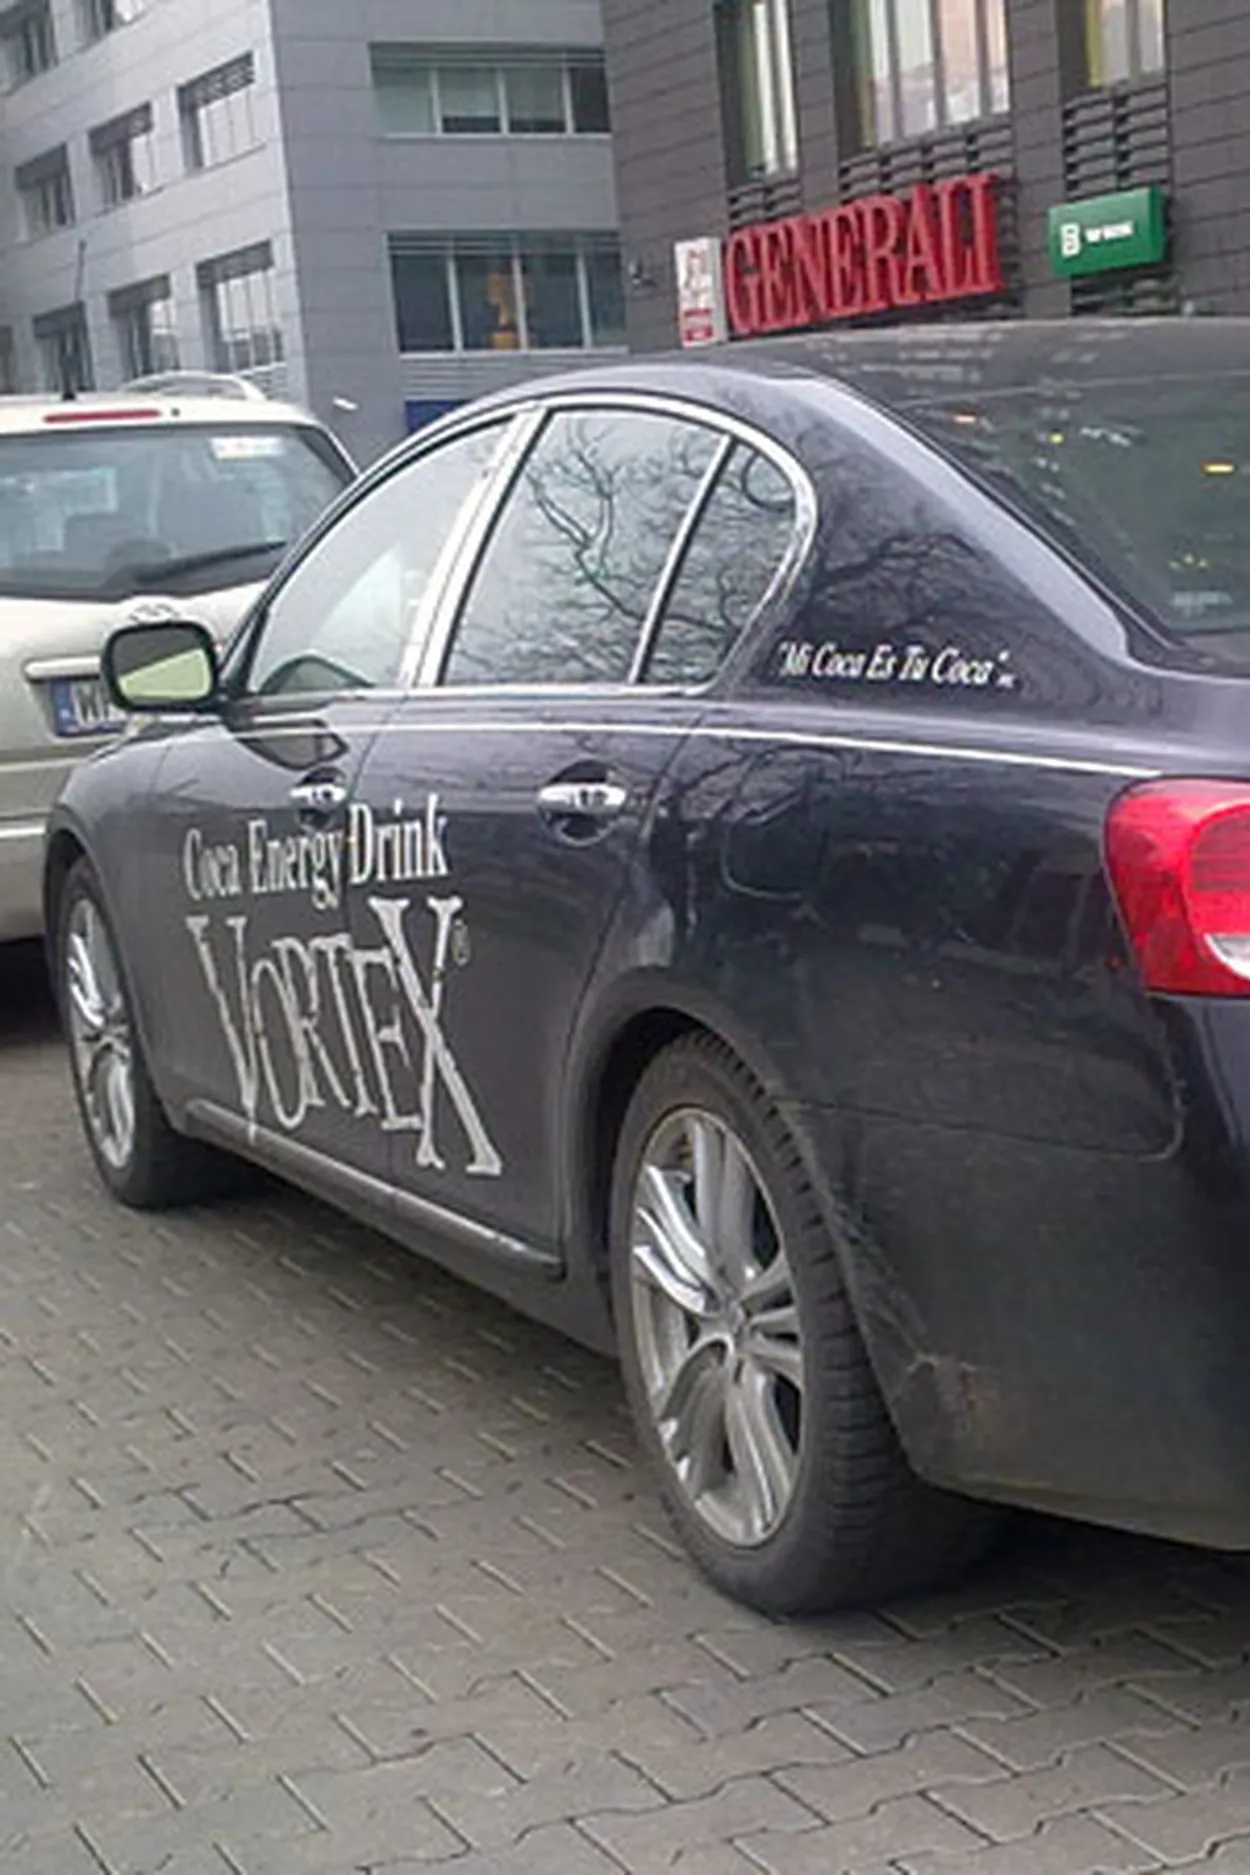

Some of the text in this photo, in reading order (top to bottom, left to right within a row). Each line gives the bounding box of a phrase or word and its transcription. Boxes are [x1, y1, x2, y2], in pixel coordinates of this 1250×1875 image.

[726, 173, 1000, 333] GENERALI
[811, 643, 866, 679] Coca
[866, 645, 896, 680] Es
[183, 793, 449, 910] Coca Energy Drink
